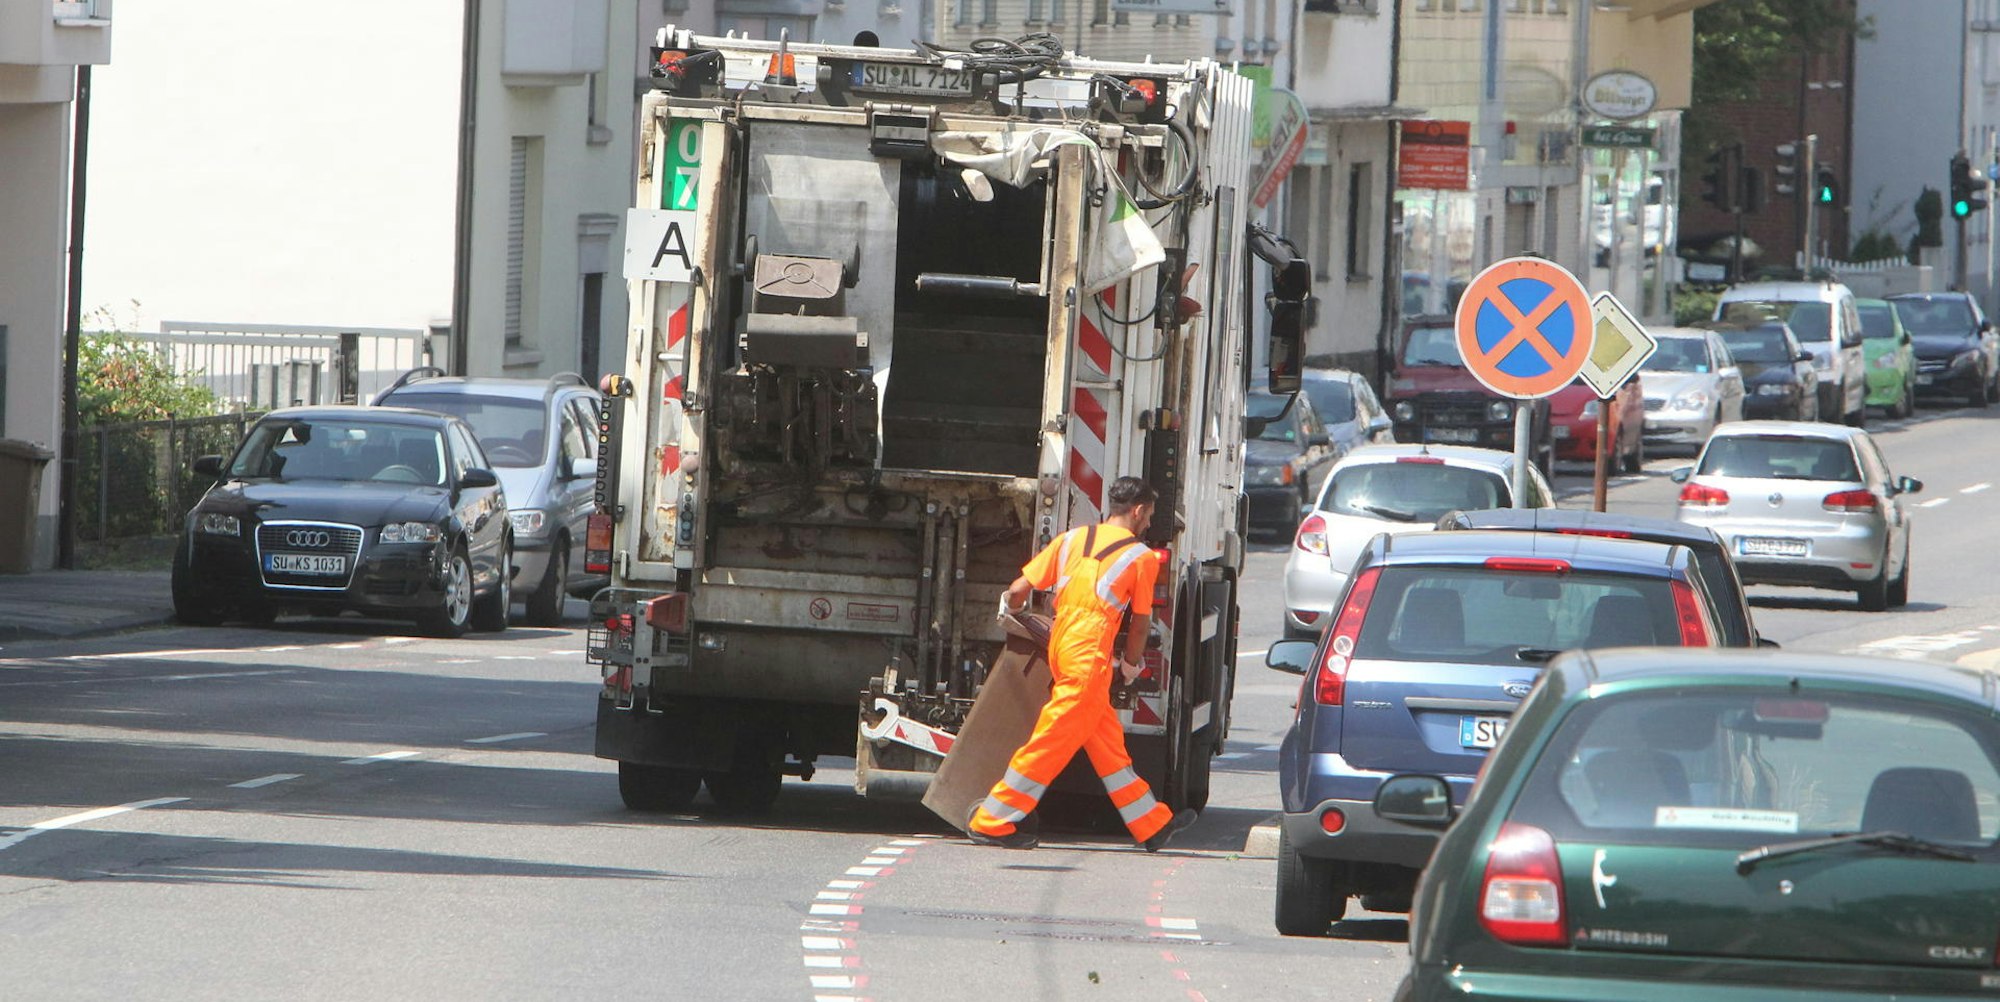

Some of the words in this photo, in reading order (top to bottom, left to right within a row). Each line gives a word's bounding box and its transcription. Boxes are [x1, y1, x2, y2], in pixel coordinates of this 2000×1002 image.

[865, 65, 886, 85] SU
[901, 68, 922, 87] AL
[928, 69, 970, 91] 7124
[651, 221, 692, 270] A
[273, 556, 288, 569] SU
[295, 556, 310, 570] KS
[313, 557, 342, 571] 1031
[1591, 928, 1668, 947] MITSUBISHI
[1929, 946, 1986, 959] COLT
